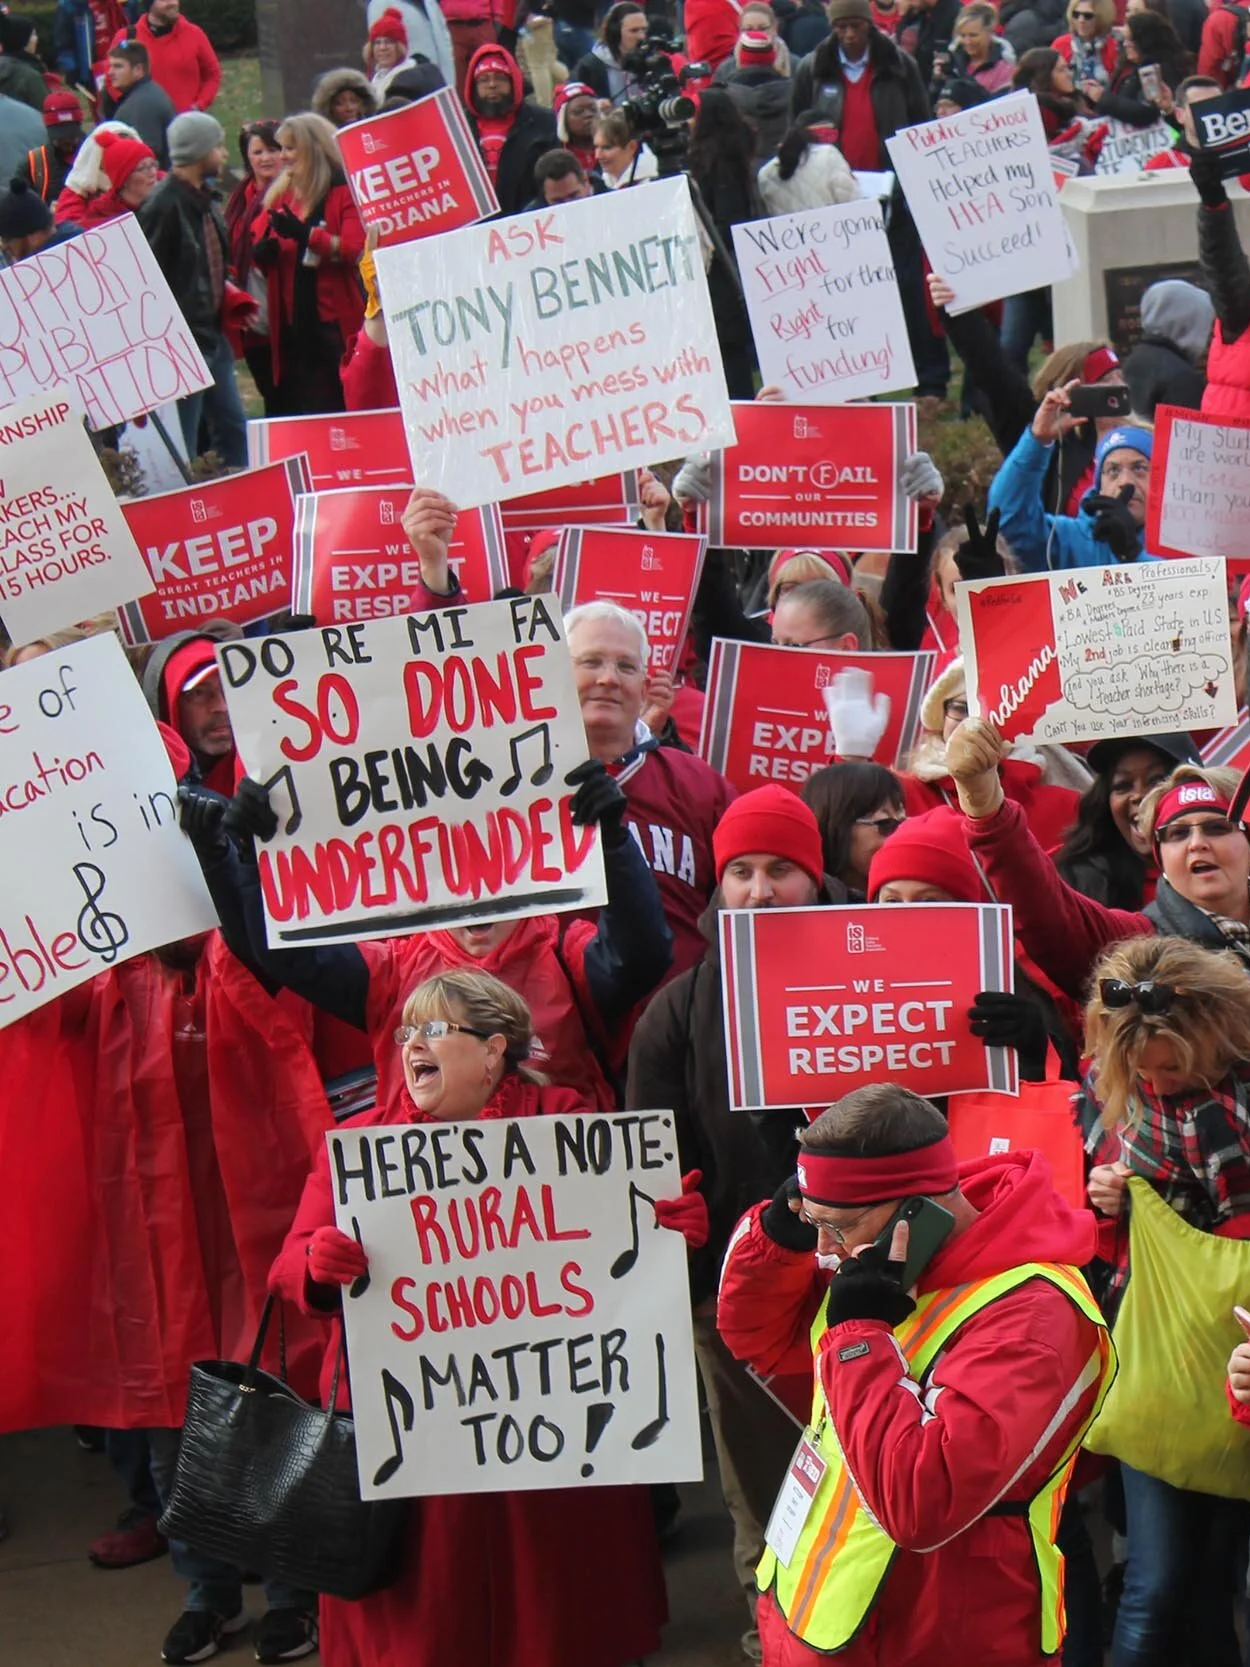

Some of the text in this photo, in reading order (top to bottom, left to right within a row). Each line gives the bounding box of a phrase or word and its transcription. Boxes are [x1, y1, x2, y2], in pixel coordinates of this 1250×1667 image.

[1004, 162, 1036, 190] my
[487, 214, 564, 264] ASK
[392, 234, 697, 369] TONY BENNETT
[819, 275, 853, 295] for
[825, 315, 858, 340] for
[409, 321, 647, 403] what happens
[418, 346, 712, 443] when you mess with
[480, 393, 708, 484] TEACHERS
[1174, 421, 1202, 449] My
[738, 465, 808, 482] DON'T
[1180, 447, 1206, 463] are
[336, 468, 362, 481] WE
[54, 497, 90, 527] MY
[795, 493, 821, 501] OUR
[1172, 482, 1216, 508] than
[58, 518, 108, 550] FOR
[738, 511, 878, 527] COMMUNITIES
[25, 544, 112, 590] HOURS.
[146, 516, 277, 583] KEEP
[385, 545, 411, 555] WE
[158, 555, 283, 596] GREAT TEACHERS IN
[160, 569, 287, 619] INDIANA
[640, 591, 659, 603] WE
[1157, 591, 1184, 609] years
[1189, 588, 1209, 600] exp
[220, 596, 561, 688] DO RE MI FA
[1063, 622, 1113, 649] Lowest
[1153, 611, 1185, 633] State
[1084, 647, 1107, 662] 2nd
[38, 665, 78, 717] of
[272, 644, 558, 762] SO DONE
[329, 736, 494, 827] BEING
[72, 803, 118, 851] is
[258, 793, 597, 922] UNDERFUNDED
[852, 979, 885, 993] WE
[785, 1000, 953, 1038] EXPECT
[788, 1040, 957, 1076] RESPECT
[332, 1115, 674, 1205] HERE'S A NOTE:
[410, 1184, 592, 1265] RURAL
[390, 1261, 594, 1342] SCHOOLS
[419, 1328, 630, 1410] MATTER
